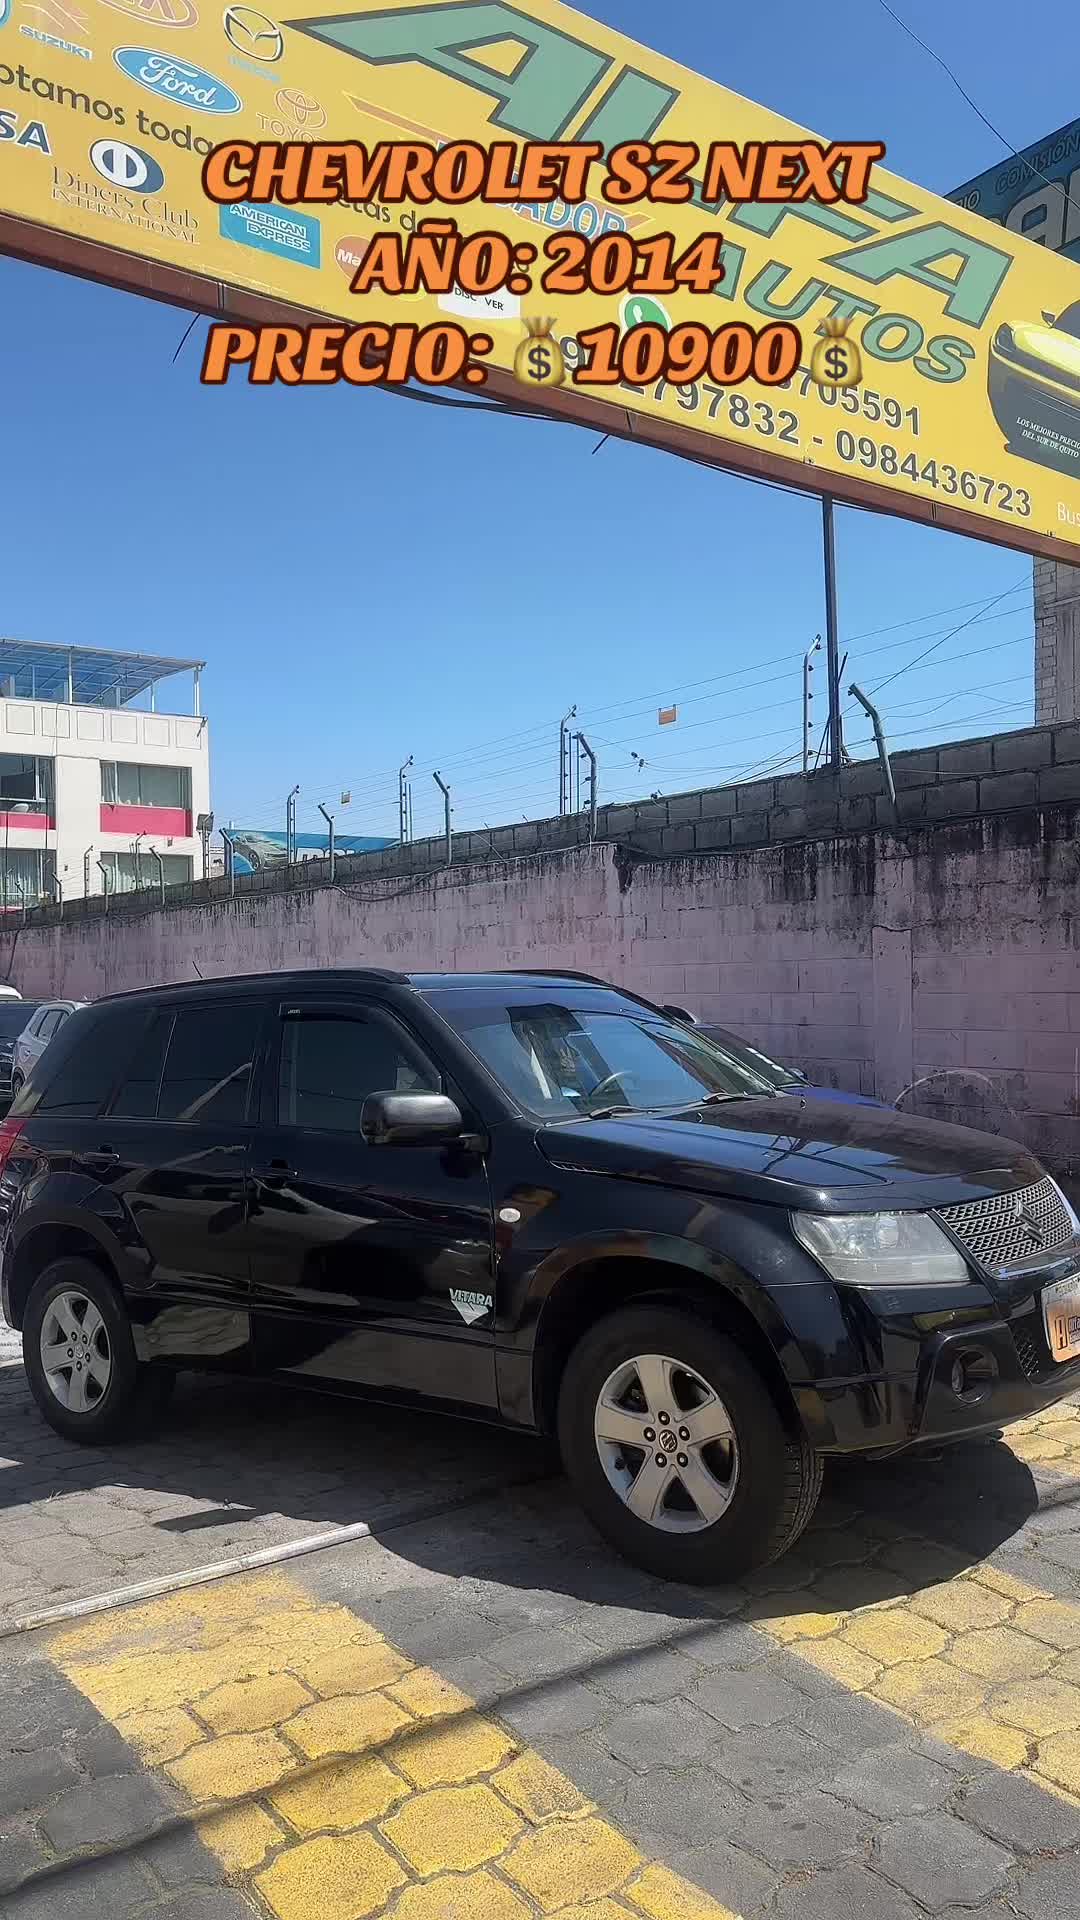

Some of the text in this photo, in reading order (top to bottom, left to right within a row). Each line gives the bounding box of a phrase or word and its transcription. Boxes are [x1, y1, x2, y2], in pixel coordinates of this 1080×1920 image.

[19, 24, 92, 60] SUZUKI
[139, 54, 216, 106] Ford
[136, 109, 214, 156] toda
[53, 166, 199, 229] Diners Club
[52, 188, 200, 245] INTERNATIONAL
[229, 203, 307, 239] AMERICAN
[246, 221, 311, 253] EXPRESS
[1016, 416, 1030, 428] LOS
[1030, 422, 1059, 441] MEJORES
[1021, 429, 1079, 458] DEL SUR DE QUITO
[835, 429, 1033, 518] 0984436723
[448, 1287, 493, 1307] VITARA
